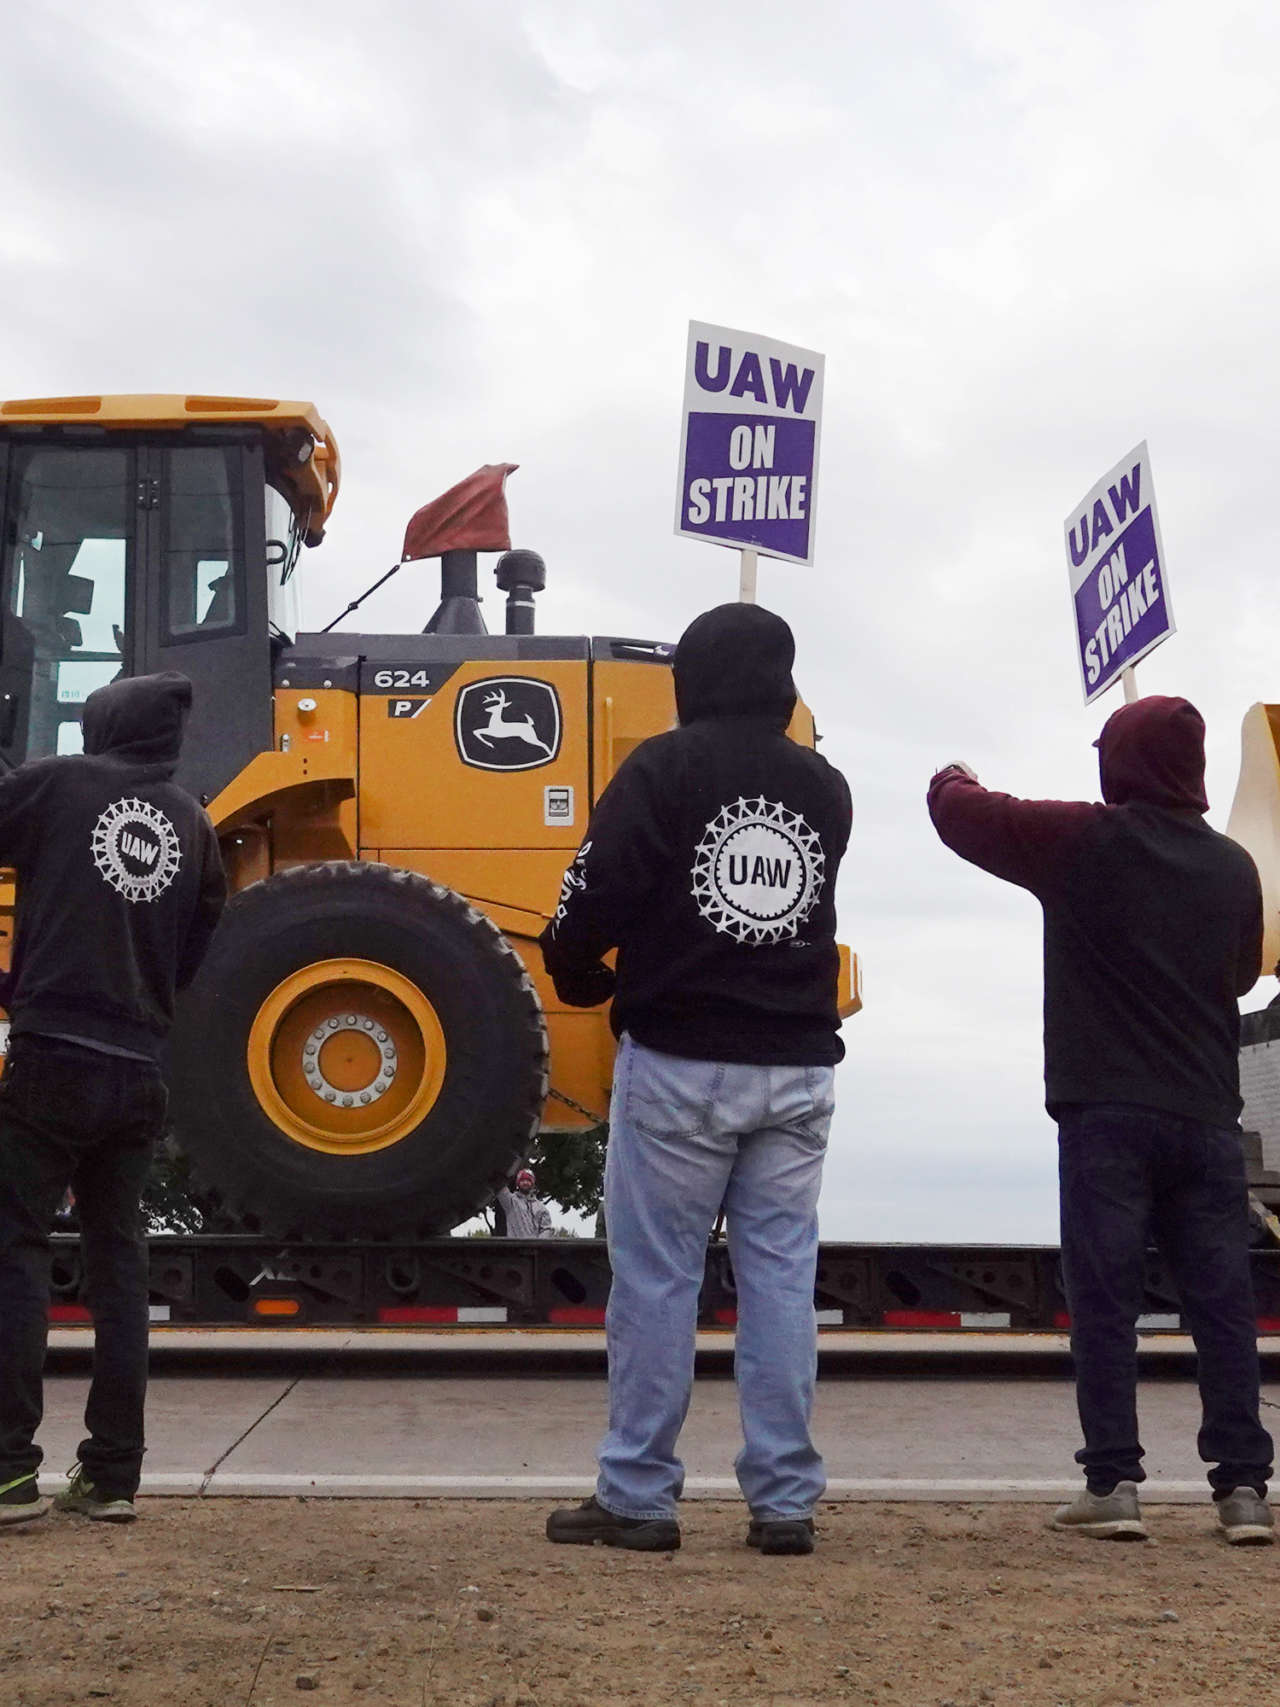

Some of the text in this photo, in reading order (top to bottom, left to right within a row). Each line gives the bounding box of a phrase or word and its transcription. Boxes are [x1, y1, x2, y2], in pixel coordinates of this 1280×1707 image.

[694, 340, 816, 415] UAW
[729, 424, 776, 471] ON
[687, 475, 807, 525] STRIKE
[1068, 462, 1141, 567] UAW
[1097, 542, 1129, 611] ON
[1084, 558, 1160, 685] STRIKE
[374, 670, 430, 688] 624
[121, 831, 160, 866] UAW
[728, 854, 792, 889] UAW
